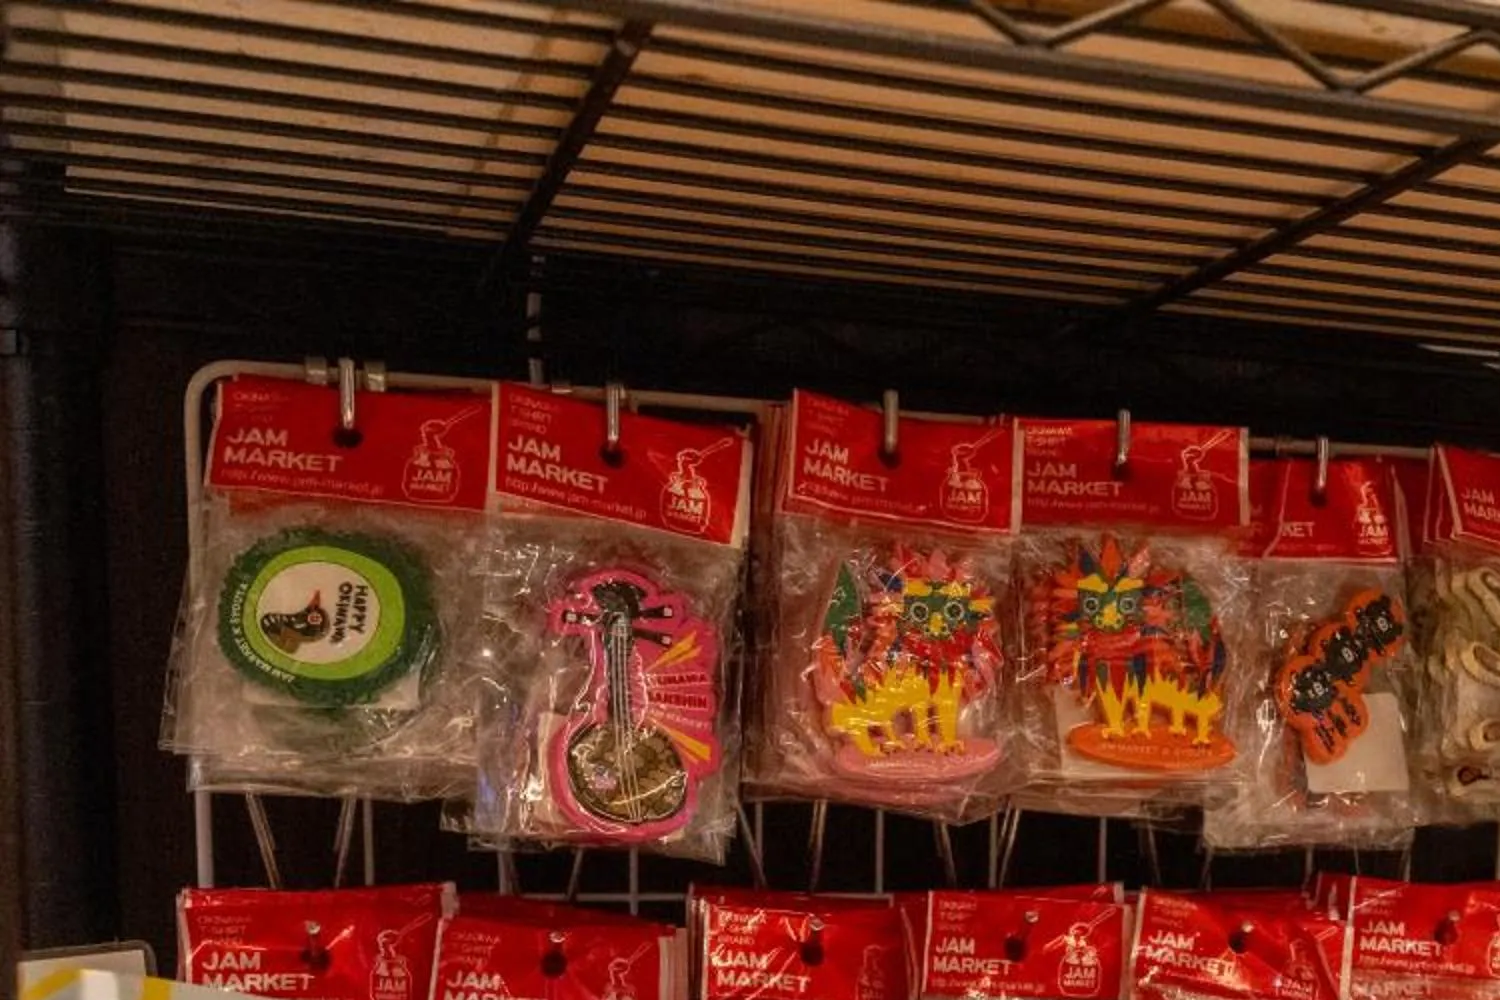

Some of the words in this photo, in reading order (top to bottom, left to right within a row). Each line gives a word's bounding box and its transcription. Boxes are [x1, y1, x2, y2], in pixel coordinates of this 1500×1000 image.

[227, 427, 288, 447] JAM
[507, 434, 561, 462] JAM
[805, 439, 849, 465] JAM
[224, 446, 343, 473] MARKET
[412, 469, 452, 483] JAM
[506, 453, 609, 494] MARKET
[803, 458, 889, 493] MARKET
[1027, 462, 1077, 478] JAM
[949, 490, 983, 505] JAM
[1027, 480, 1123, 498] MARKET
[1179, 490, 1212, 504] JAM
[1461, 487, 1495, 504] JAM
[670, 499, 704, 515] JAM
[329, 581, 352, 644] OKINAWA
[350, 584, 368, 635] HAPPY
[1361, 920, 1405, 936] JAM
[935, 937, 975, 955] JAM
[1149, 929, 1195, 951] JAM
[1360, 936, 1443, 957] MARKET
[202, 951, 261, 971] JAM
[715, 950, 771, 969] JAM
[933, 957, 1012, 976] MARKET
[1146, 944, 1237, 978] MARKET
[201, 972, 315, 992] MARKET
[446, 970, 502, 991] JAM
[716, 971, 811, 993] MARKET
[1064, 967, 1096, 979] JAM
[376, 978, 406, 992] JAM
